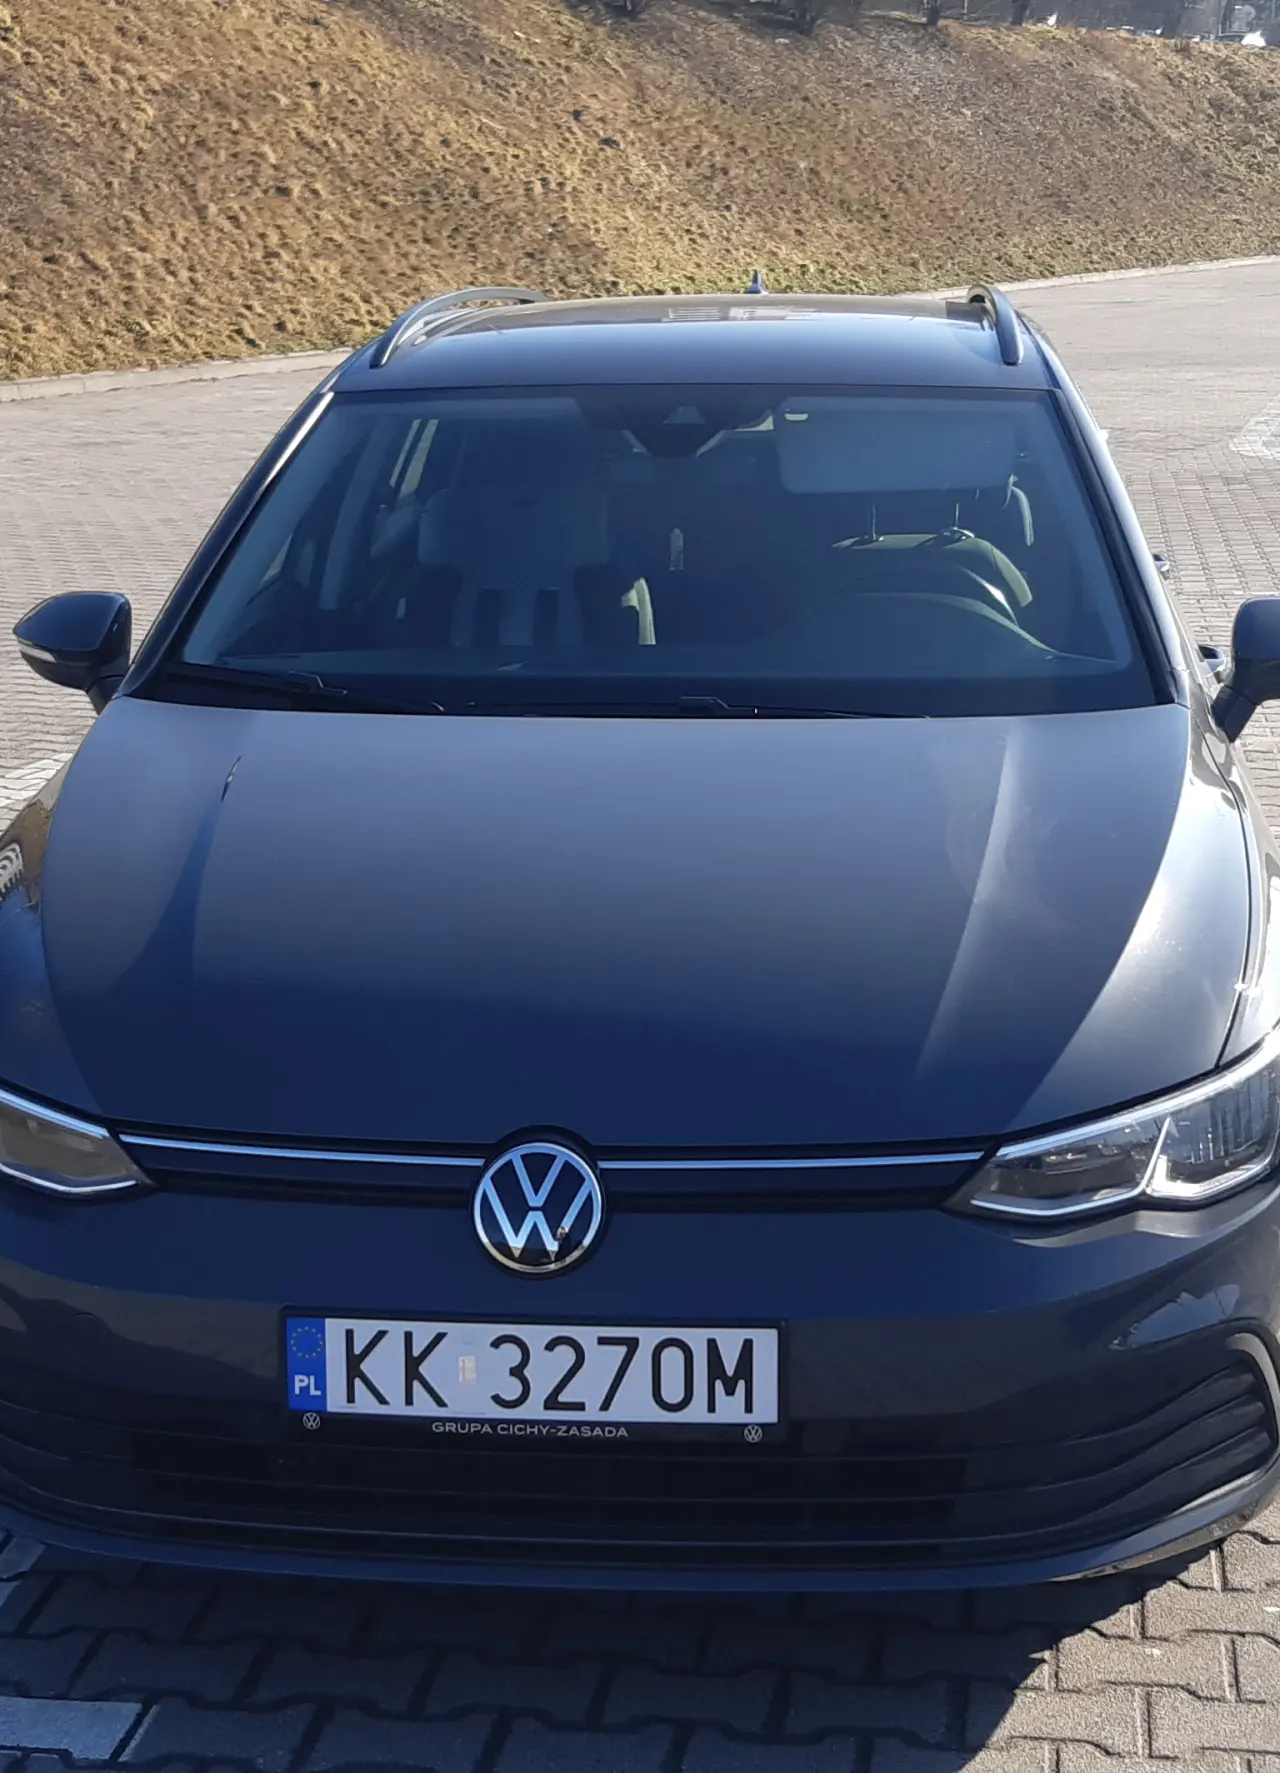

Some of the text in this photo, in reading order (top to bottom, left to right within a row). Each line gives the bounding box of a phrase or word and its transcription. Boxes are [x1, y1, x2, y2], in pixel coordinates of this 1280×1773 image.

[345, 1328, 754, 1414] KK 3270M
[294, 1375, 322, 1396] PL
[431, 1422, 629, 1438] GRUPA CICHY-ZASADA
